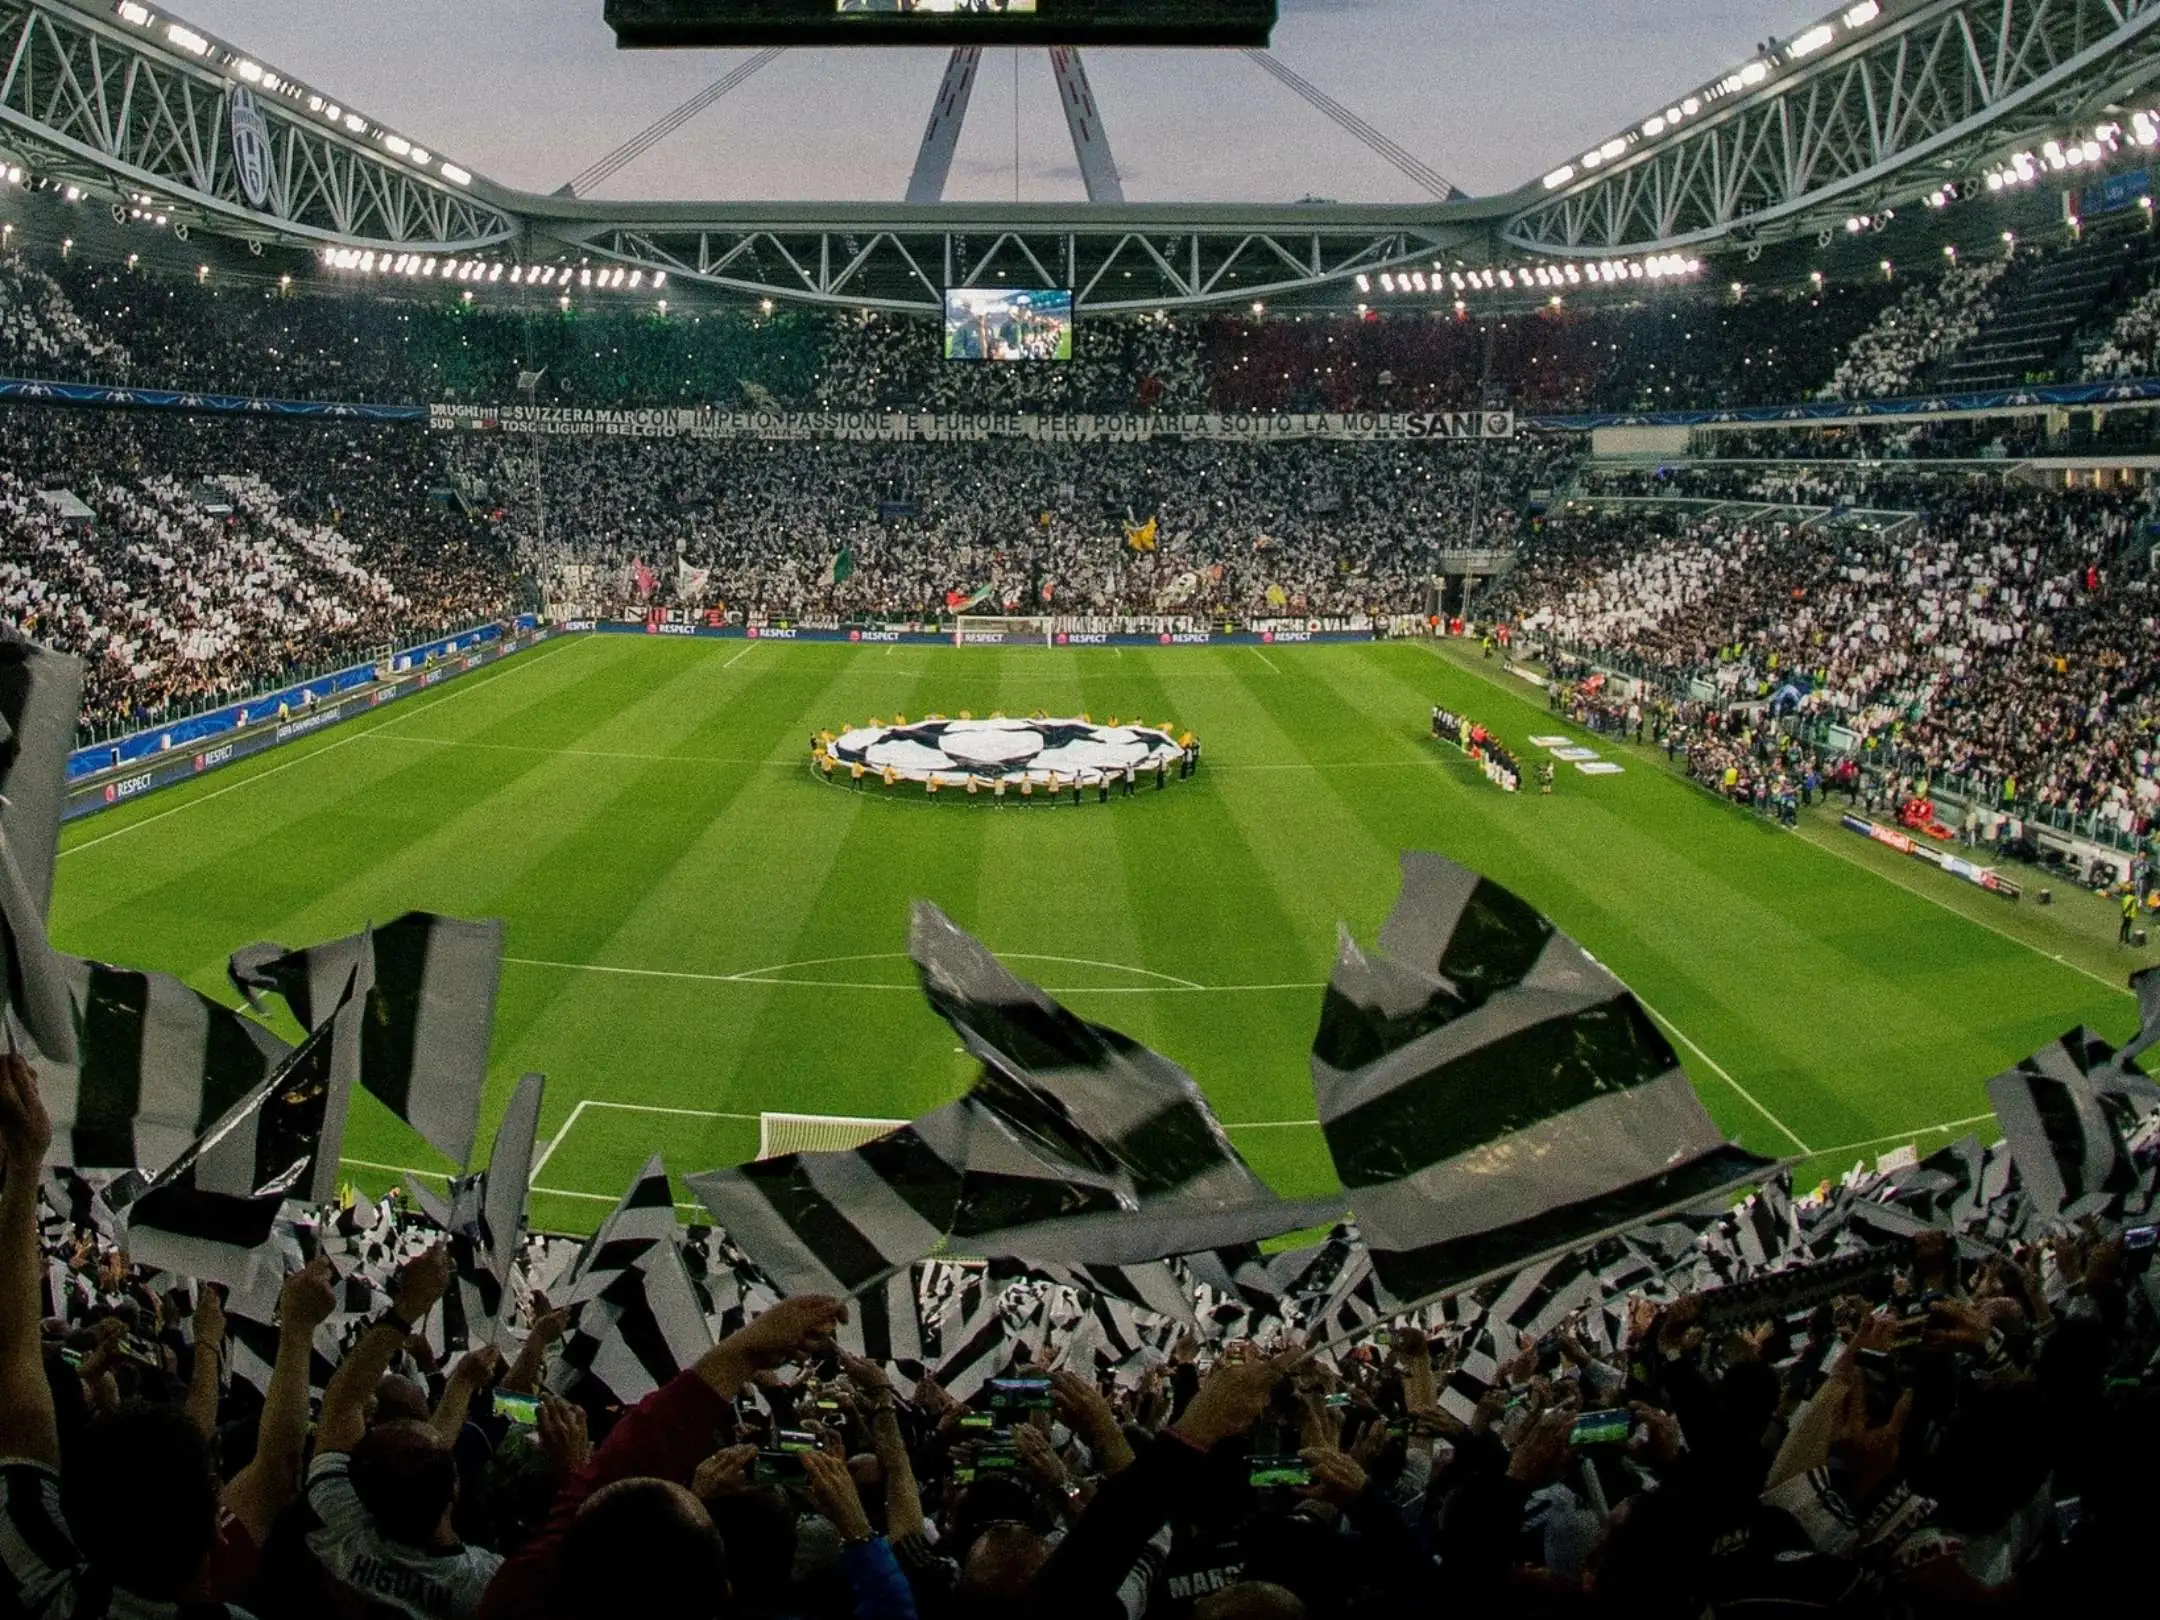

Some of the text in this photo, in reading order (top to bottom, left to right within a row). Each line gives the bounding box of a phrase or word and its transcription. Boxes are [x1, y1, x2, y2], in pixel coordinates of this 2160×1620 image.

[514, 406, 594, 421] SVIZZERA
[430, 418, 455, 430] SUD
[636, 409, 679, 426] CON
[787, 412, 892, 430] PASSIONE
[906, 414, 919, 430] E
[934, 413, 1020, 431] FURORE
[1037, 415, 1079, 431] PER
[1094, 415, 1208, 432] PORTARLA
[1220, 414, 1293, 432] SOTTO
[1303, 414, 1330, 432] LA
[606, 423, 678, 438] BELGIO
[659, 624, 697, 634] RESPECT
[760, 627, 797, 638] RESPECT
[861, 631, 899, 641] RESPECT
[964, 633, 1003, 643] RESPECT
[1068, 633, 1107, 643] RESPECT
[1172, 633, 1209, 643] RESPECT
[1274, 631, 1311, 641] RESPECT
[205, 744, 233, 767] RESPECT
[118, 773, 152, 797] RESPECT
